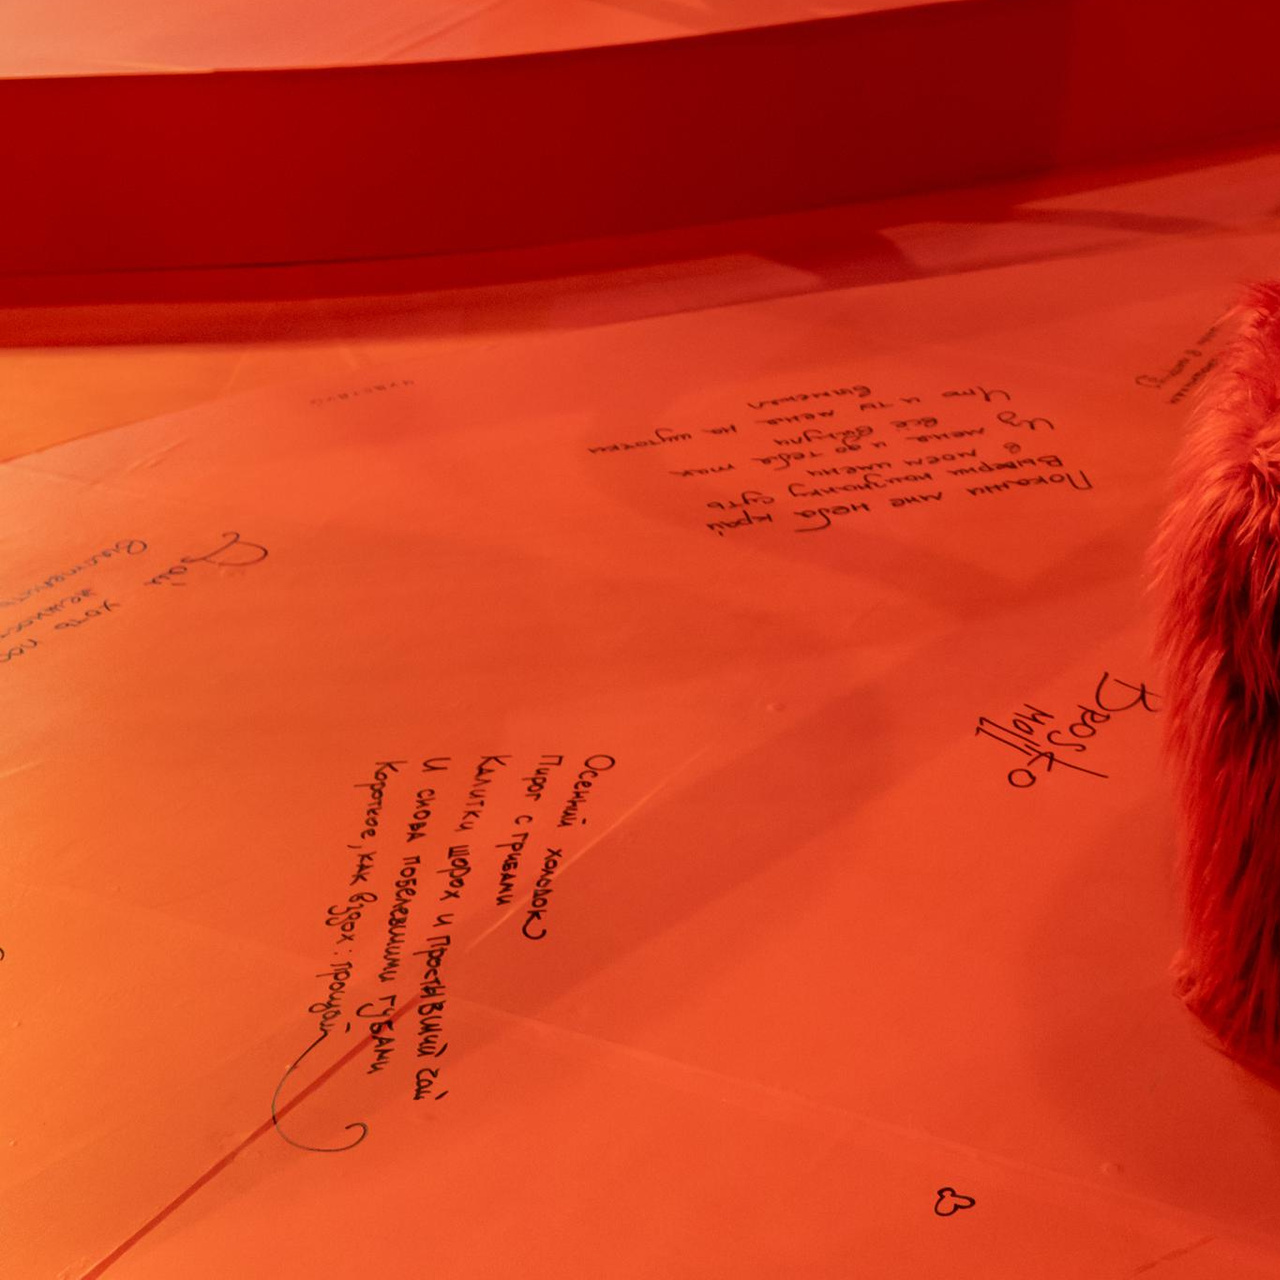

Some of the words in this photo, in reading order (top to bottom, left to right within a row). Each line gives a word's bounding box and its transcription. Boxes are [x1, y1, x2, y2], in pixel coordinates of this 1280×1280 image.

[965, 469, 1094, 497] Покажи
[889, 490, 943, 509] мне
[705, 508, 774, 538] край
[793, 501, 871, 534] неба
[421, 756, 452, 773] И
[522, 754, 565, 802] Пирог
[455, 754, 511, 832] Калитки
[556, 753, 617, 828] Осенний
